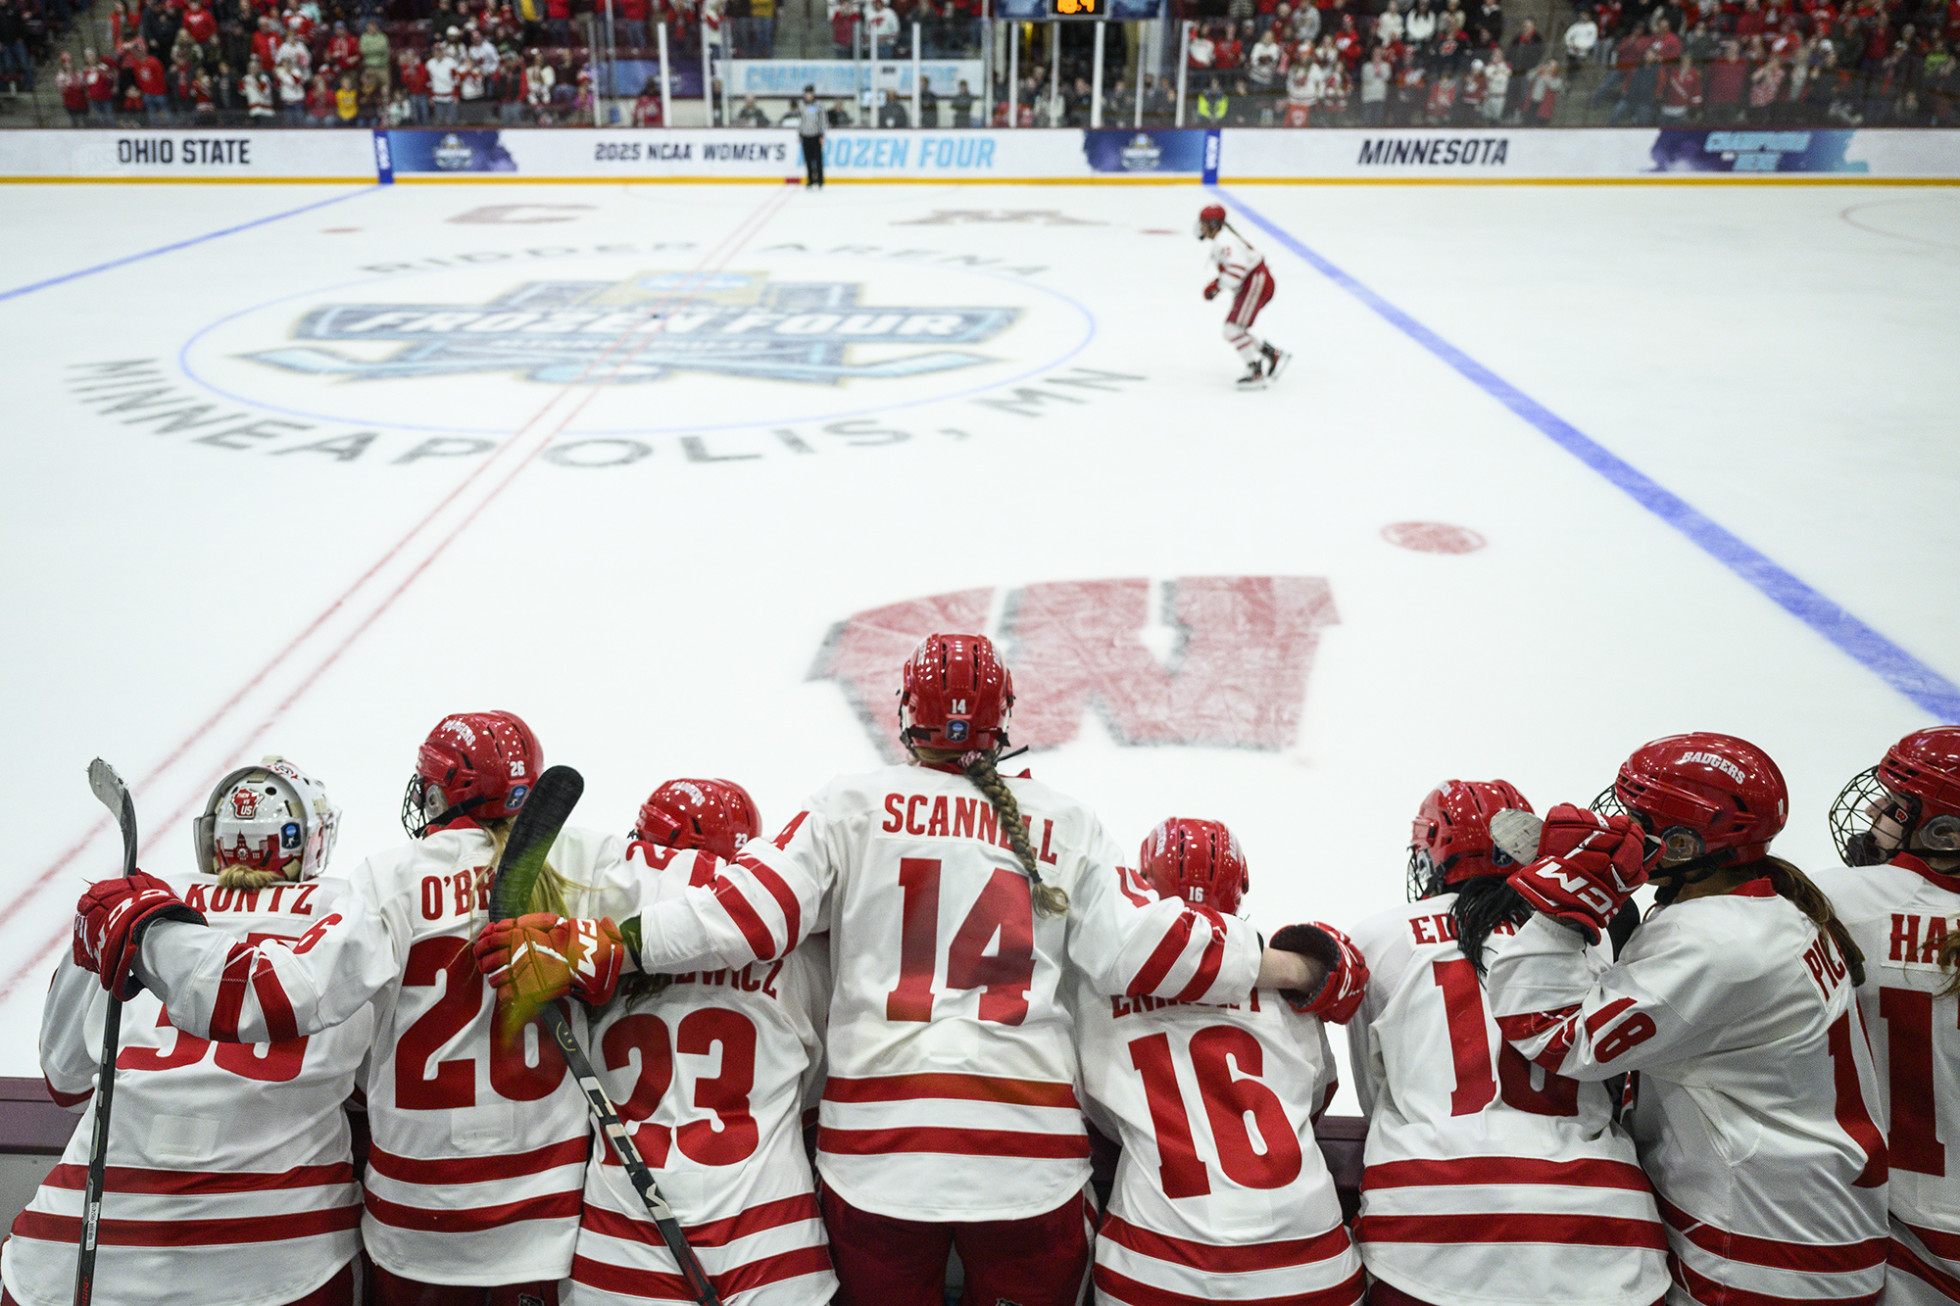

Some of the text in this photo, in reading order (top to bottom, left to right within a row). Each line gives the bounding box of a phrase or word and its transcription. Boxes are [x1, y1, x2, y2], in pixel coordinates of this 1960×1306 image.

[118, 139, 251, 165] OHIO STATE
[594, 143, 787, 161] 2025 NCAA WOMEN'S
[797, 137, 996, 169] ROZEN FOUR
[1357, 138, 1509, 166] MINNESOTA
[345, 311, 967, 336] FROZEN FOUR
[951, 699, 967, 714] 14
[509, 760, 525, 777] 26
[1679, 751, 1746, 785] BADGERS
[1188, 886, 1204, 902] 16
[886, 857, 1037, 1027] 14
[601, 1006, 758, 1169] 23
[1128, 1024, 1303, 1200] 16
